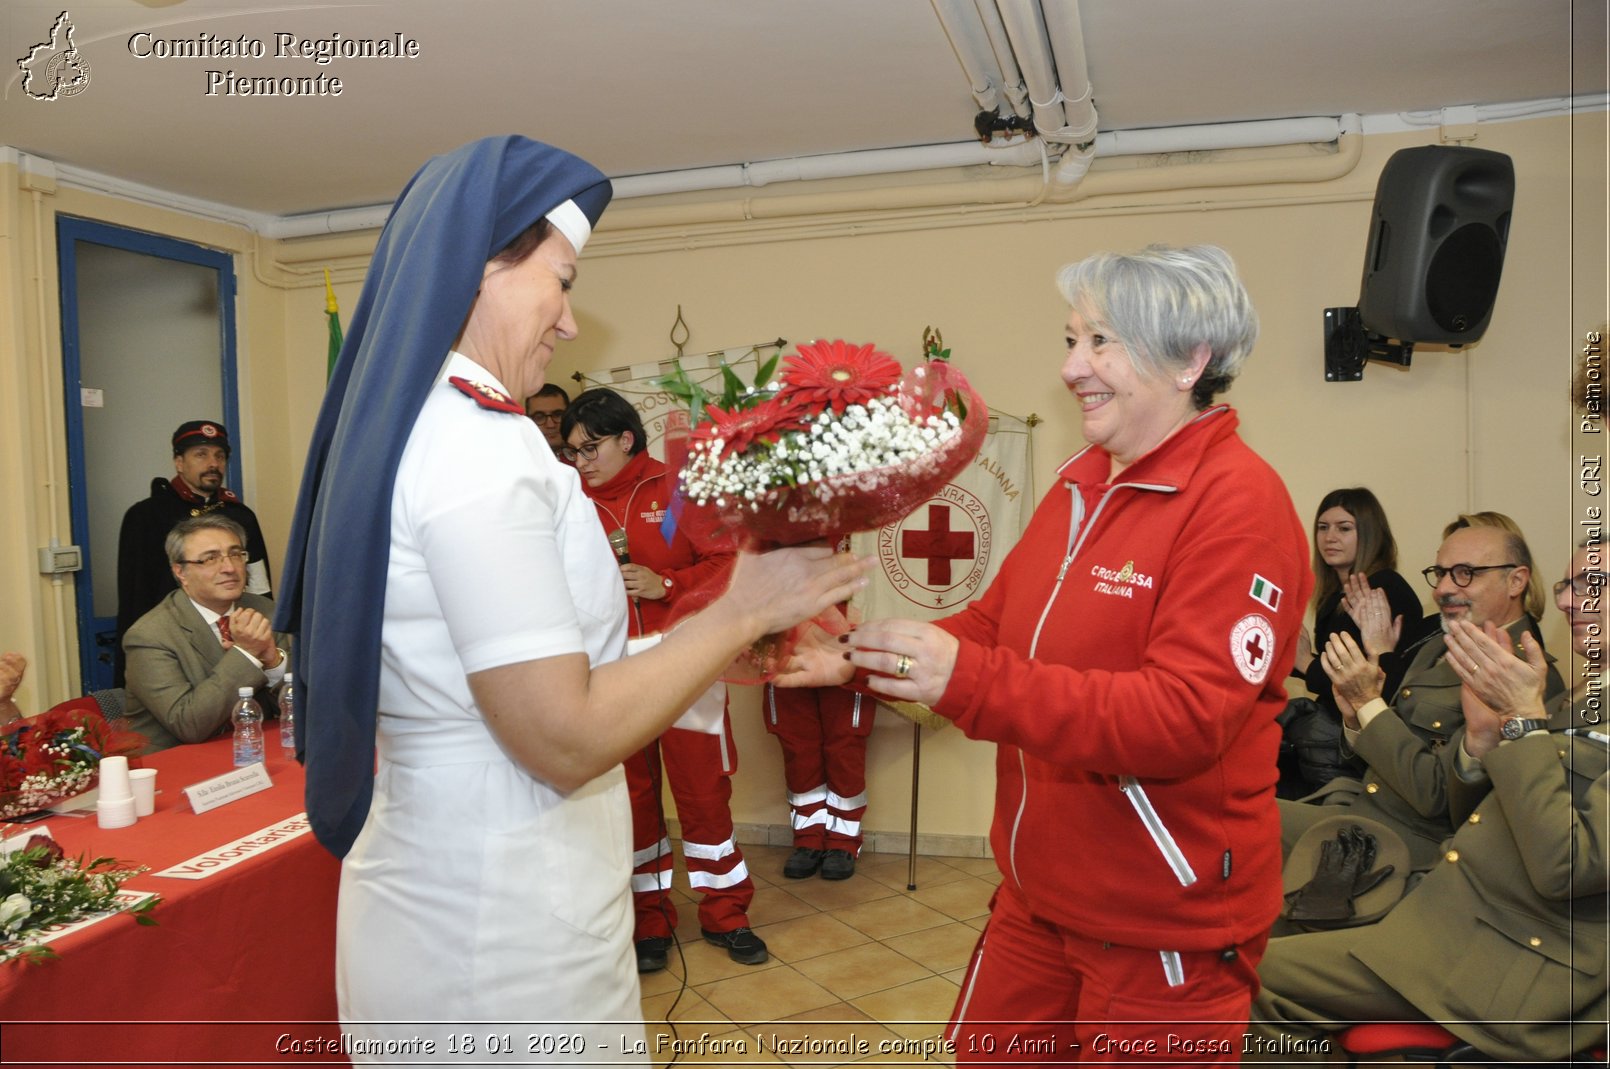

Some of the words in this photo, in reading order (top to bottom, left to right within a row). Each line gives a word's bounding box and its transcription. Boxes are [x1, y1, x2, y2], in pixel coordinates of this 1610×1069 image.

[974, 451, 1020, 502] TALIANA
[965, 499, 981, 515] 22
[976, 513, 991, 565] AGOSTO
[965, 568, 983, 591] 1864
[1091, 565, 1120, 582] CROCE
[1094, 582, 1133, 598] ITALIANA
